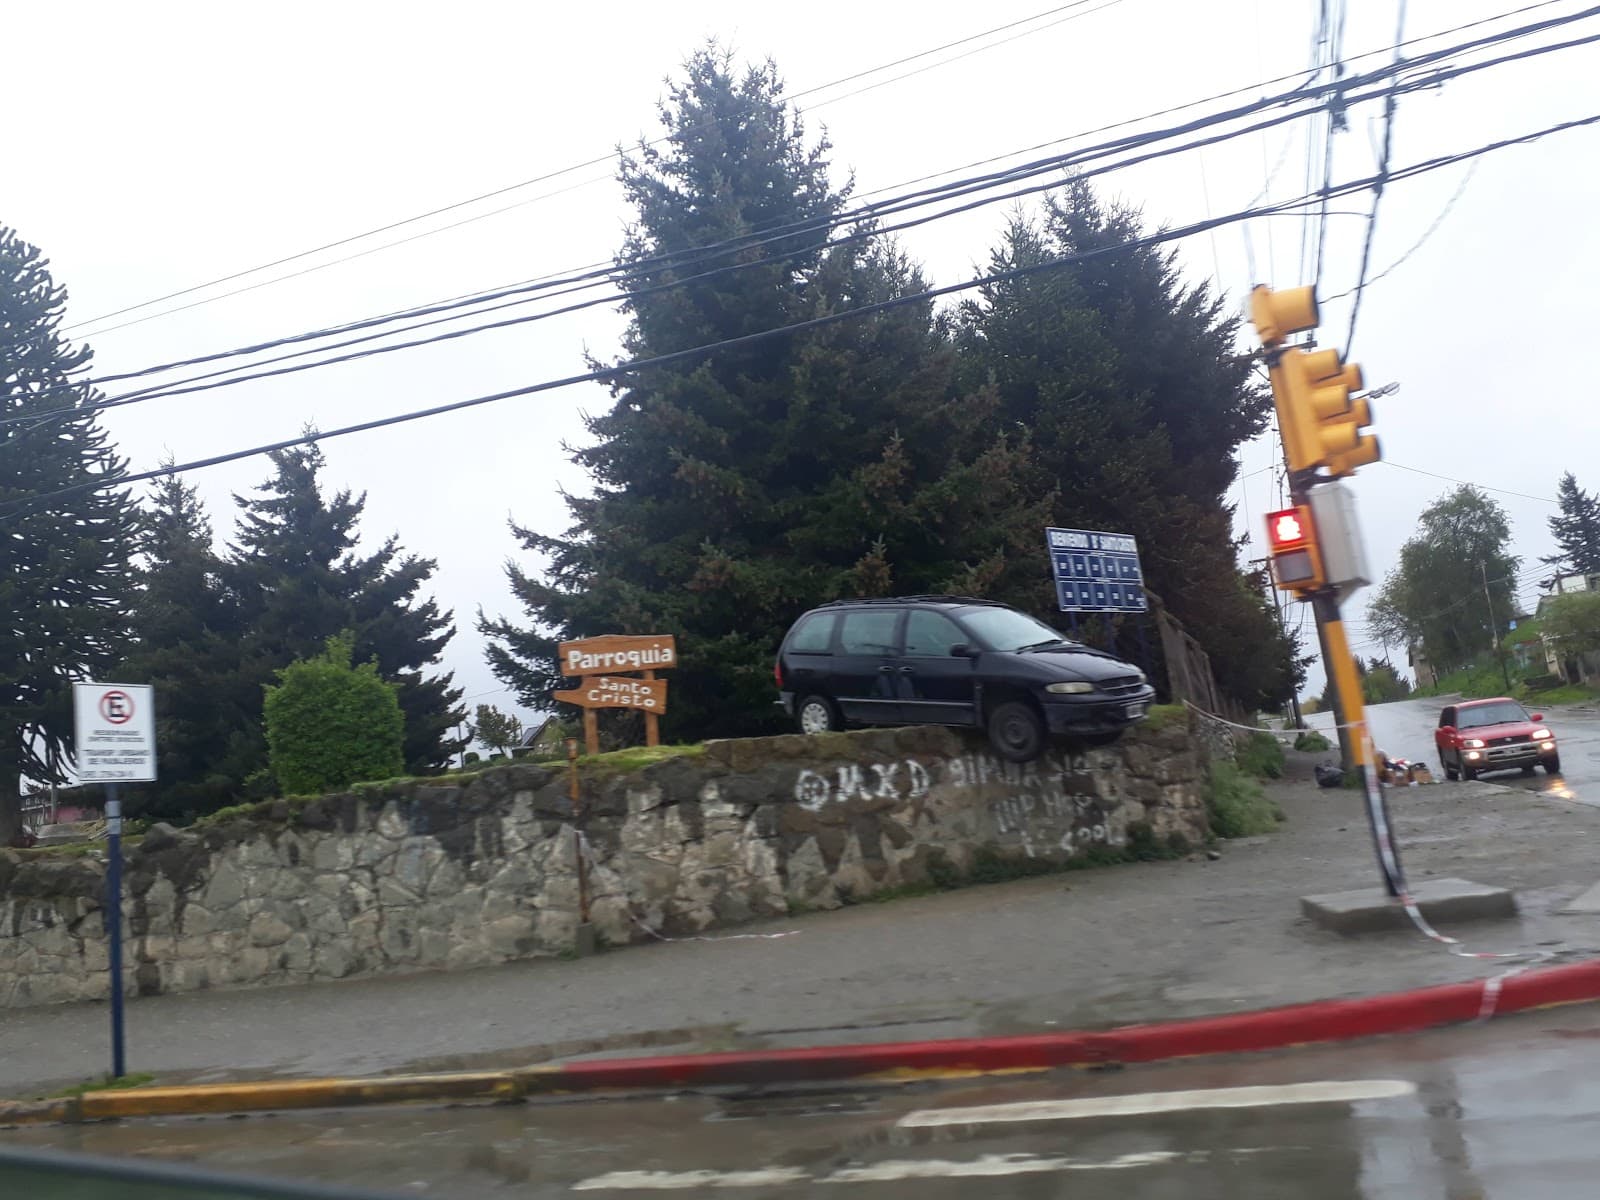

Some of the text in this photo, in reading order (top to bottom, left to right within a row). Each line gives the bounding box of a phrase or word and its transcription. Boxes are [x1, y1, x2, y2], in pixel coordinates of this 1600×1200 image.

[567, 644, 673, 670] Parroquia
[599, 677, 652, 695] Santo
[109, 696, 124, 717] E
[587, 689, 657, 708] Cristo
